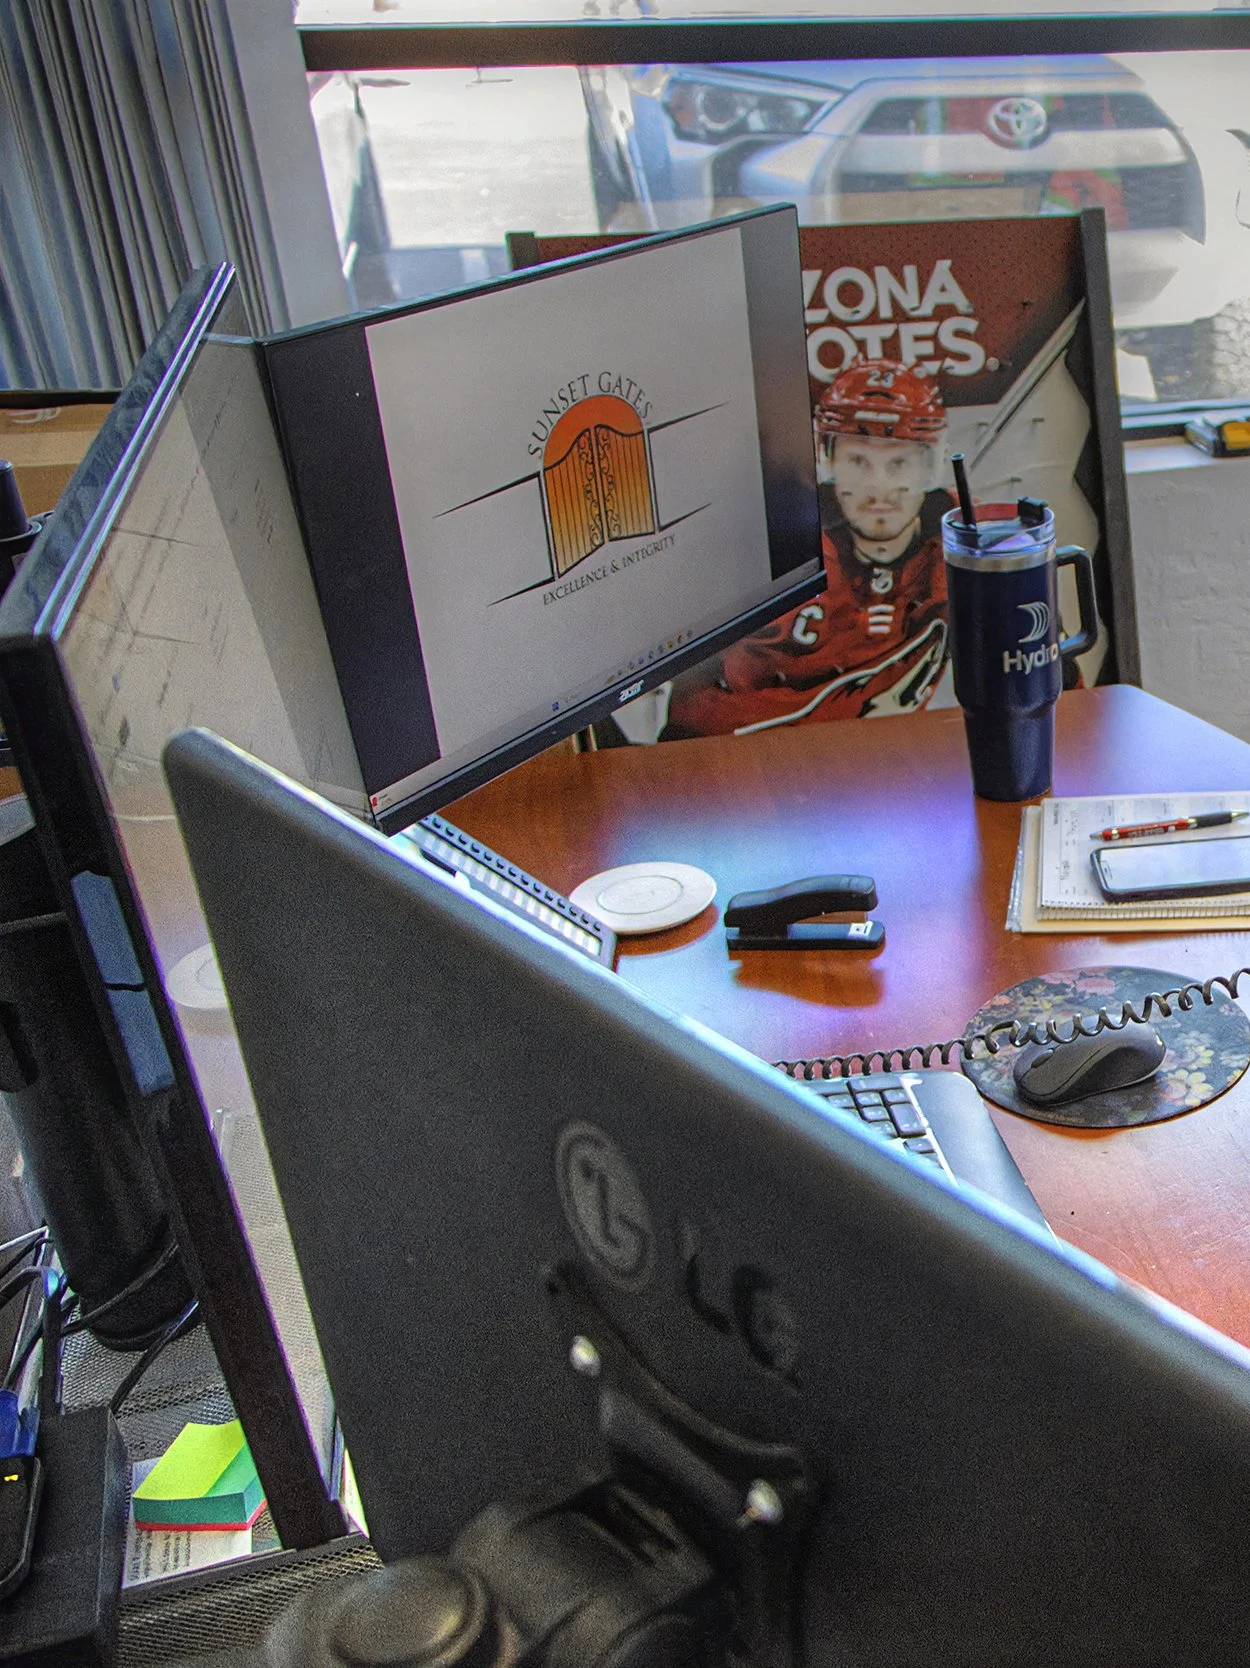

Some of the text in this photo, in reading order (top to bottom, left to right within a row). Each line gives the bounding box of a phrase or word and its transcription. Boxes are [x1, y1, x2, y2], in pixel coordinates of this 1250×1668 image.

[528, 371, 653, 460] SUNSET GATES
[543, 533, 677, 606] EXCELLENCE & INTEGRITY
[792, 605, 824, 645] C
[1003, 643, 1059, 675] Hydro
